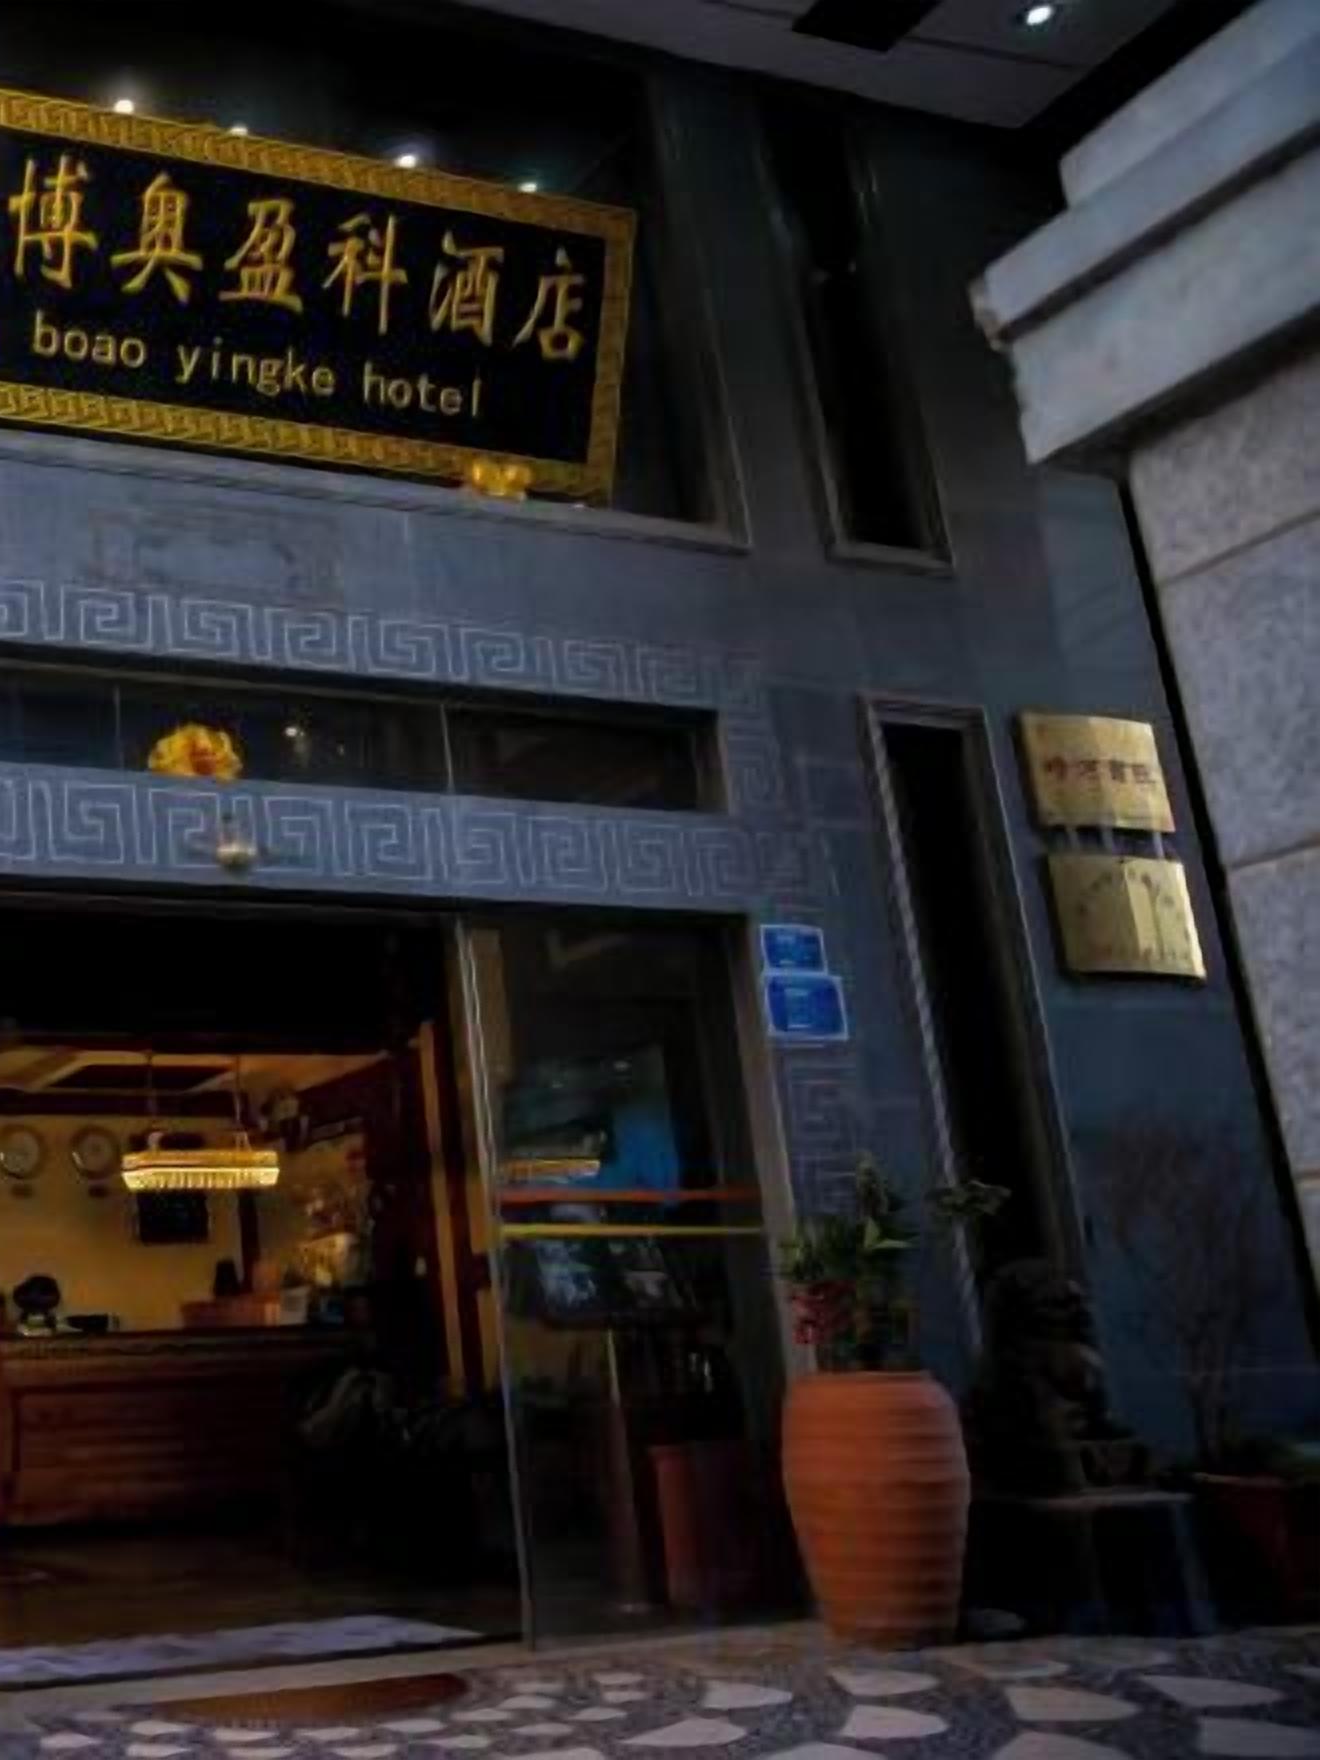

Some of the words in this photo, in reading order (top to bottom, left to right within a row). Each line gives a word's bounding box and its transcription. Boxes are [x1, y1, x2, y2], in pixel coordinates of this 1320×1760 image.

[33, 310, 147, 368] boao
[175, 335, 336, 397] yingke
[362, 361, 483, 418] hotel
